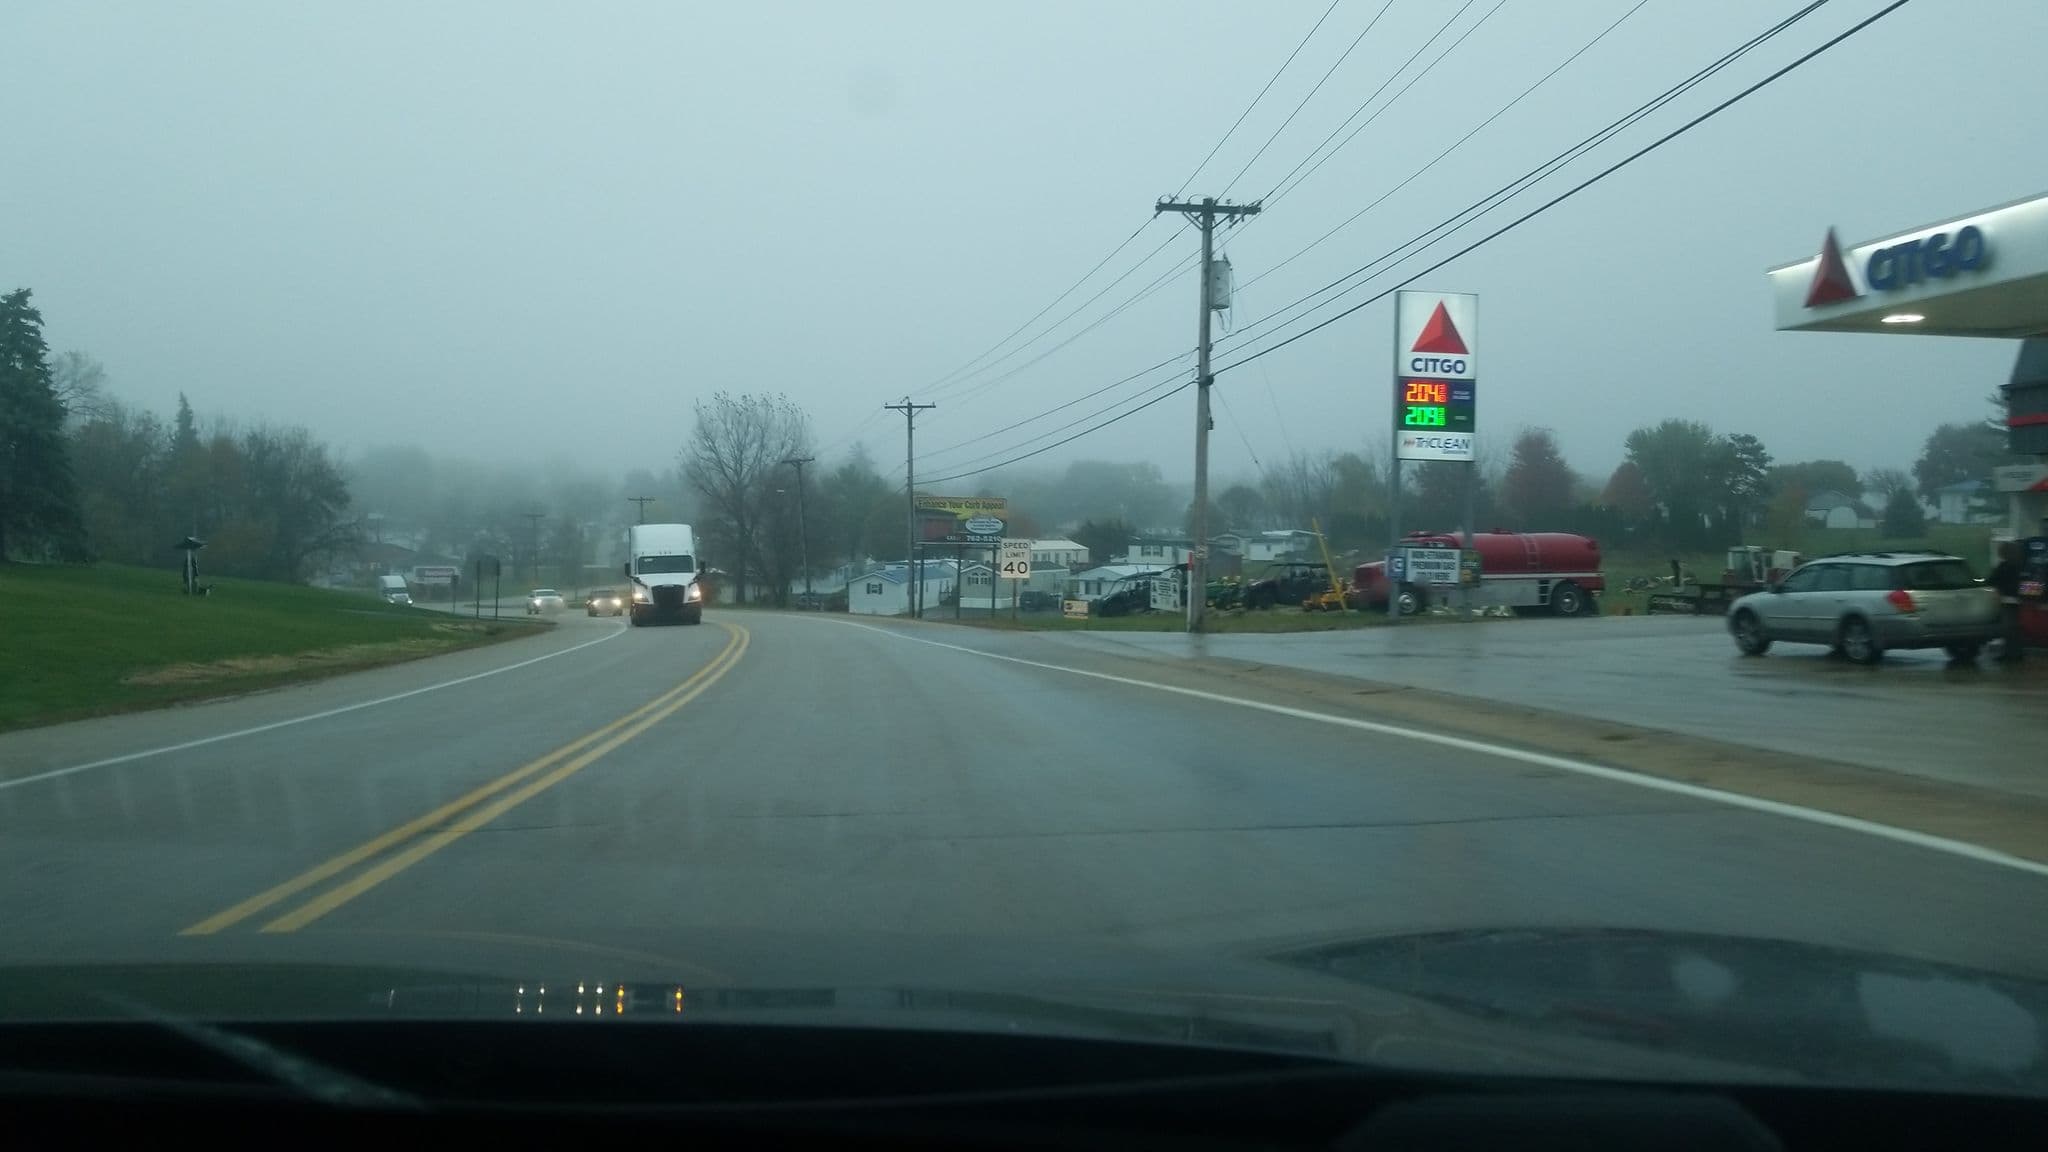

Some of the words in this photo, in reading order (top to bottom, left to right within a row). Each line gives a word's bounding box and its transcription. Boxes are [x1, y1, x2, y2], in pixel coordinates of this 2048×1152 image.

[1868, 225, 1985, 290] CITGO
[1411, 357, 1466, 374] CITGO
[1003, 561, 1028, 575] 40
